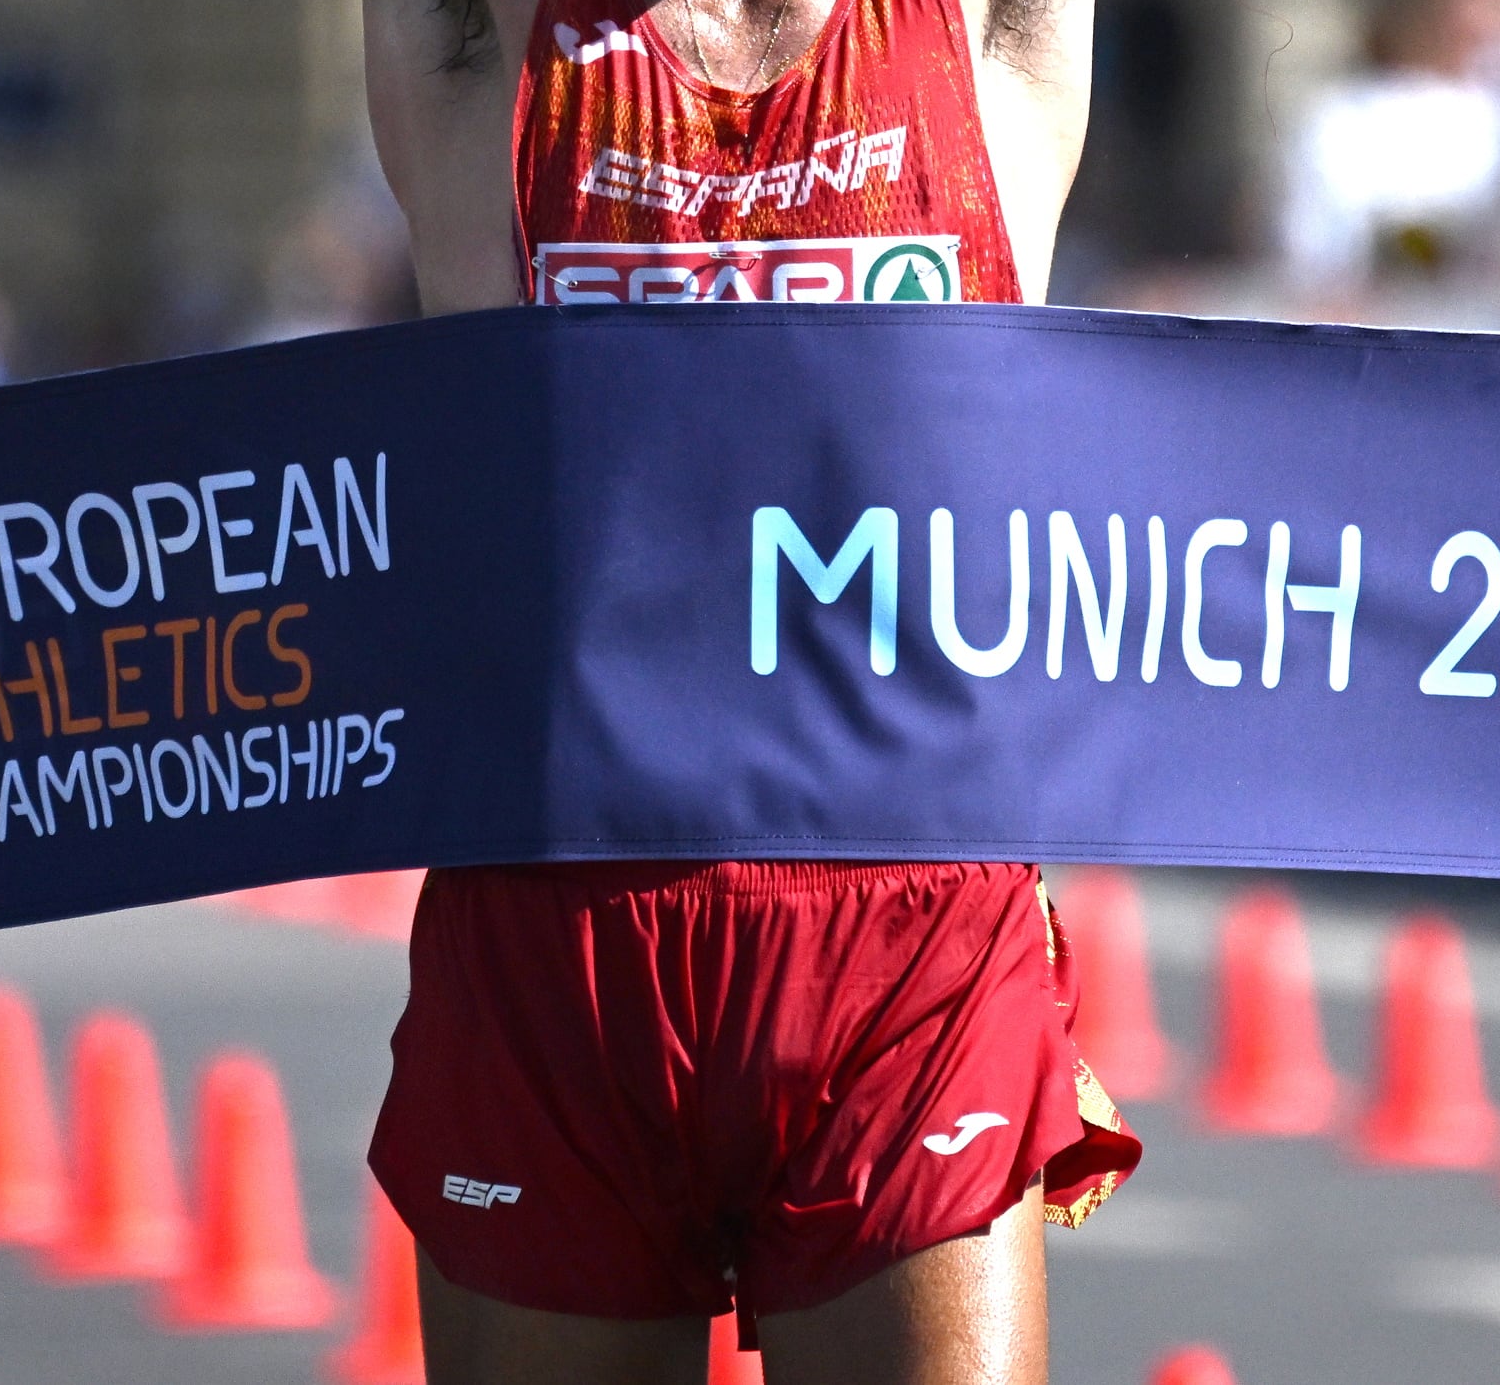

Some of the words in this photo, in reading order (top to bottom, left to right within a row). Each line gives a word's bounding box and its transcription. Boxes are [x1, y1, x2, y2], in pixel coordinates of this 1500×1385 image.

[577, 125, 907, 218] ESPAÑA
[750, 506, 1362, 692] MUNICH
[442, 1174, 522, 1210] ESP
